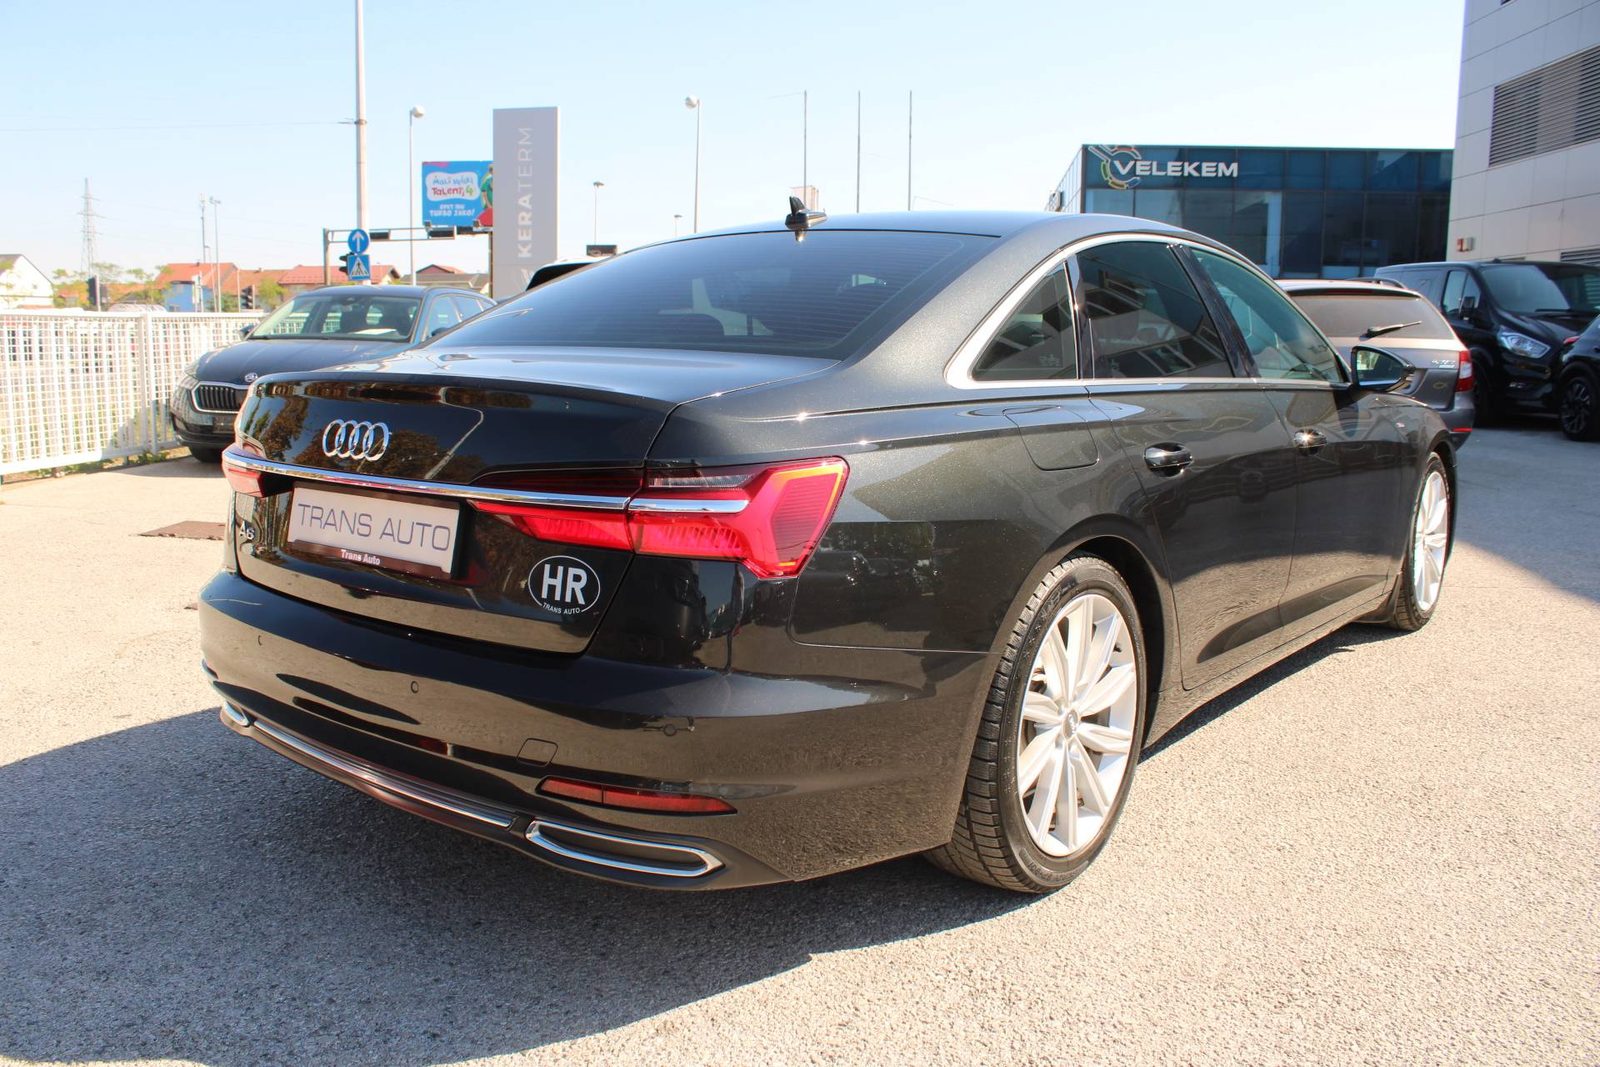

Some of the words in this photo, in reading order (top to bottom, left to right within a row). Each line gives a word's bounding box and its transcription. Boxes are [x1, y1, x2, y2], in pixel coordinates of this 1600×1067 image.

[1113, 160, 1238, 177] VELEKEM
[518, 128, 533, 258] KERATERM
[239, 520, 255, 540] A6
[297, 503, 373, 538] TRANS
[379, 517, 451, 551] AUTO
[341, 549, 361, 561] Trans
[362, 553, 381, 565] Auto
[541, 563, 588, 605] HR
[542, 602, 562, 614] TRANS
[563, 607, 581, 615] AUTO
